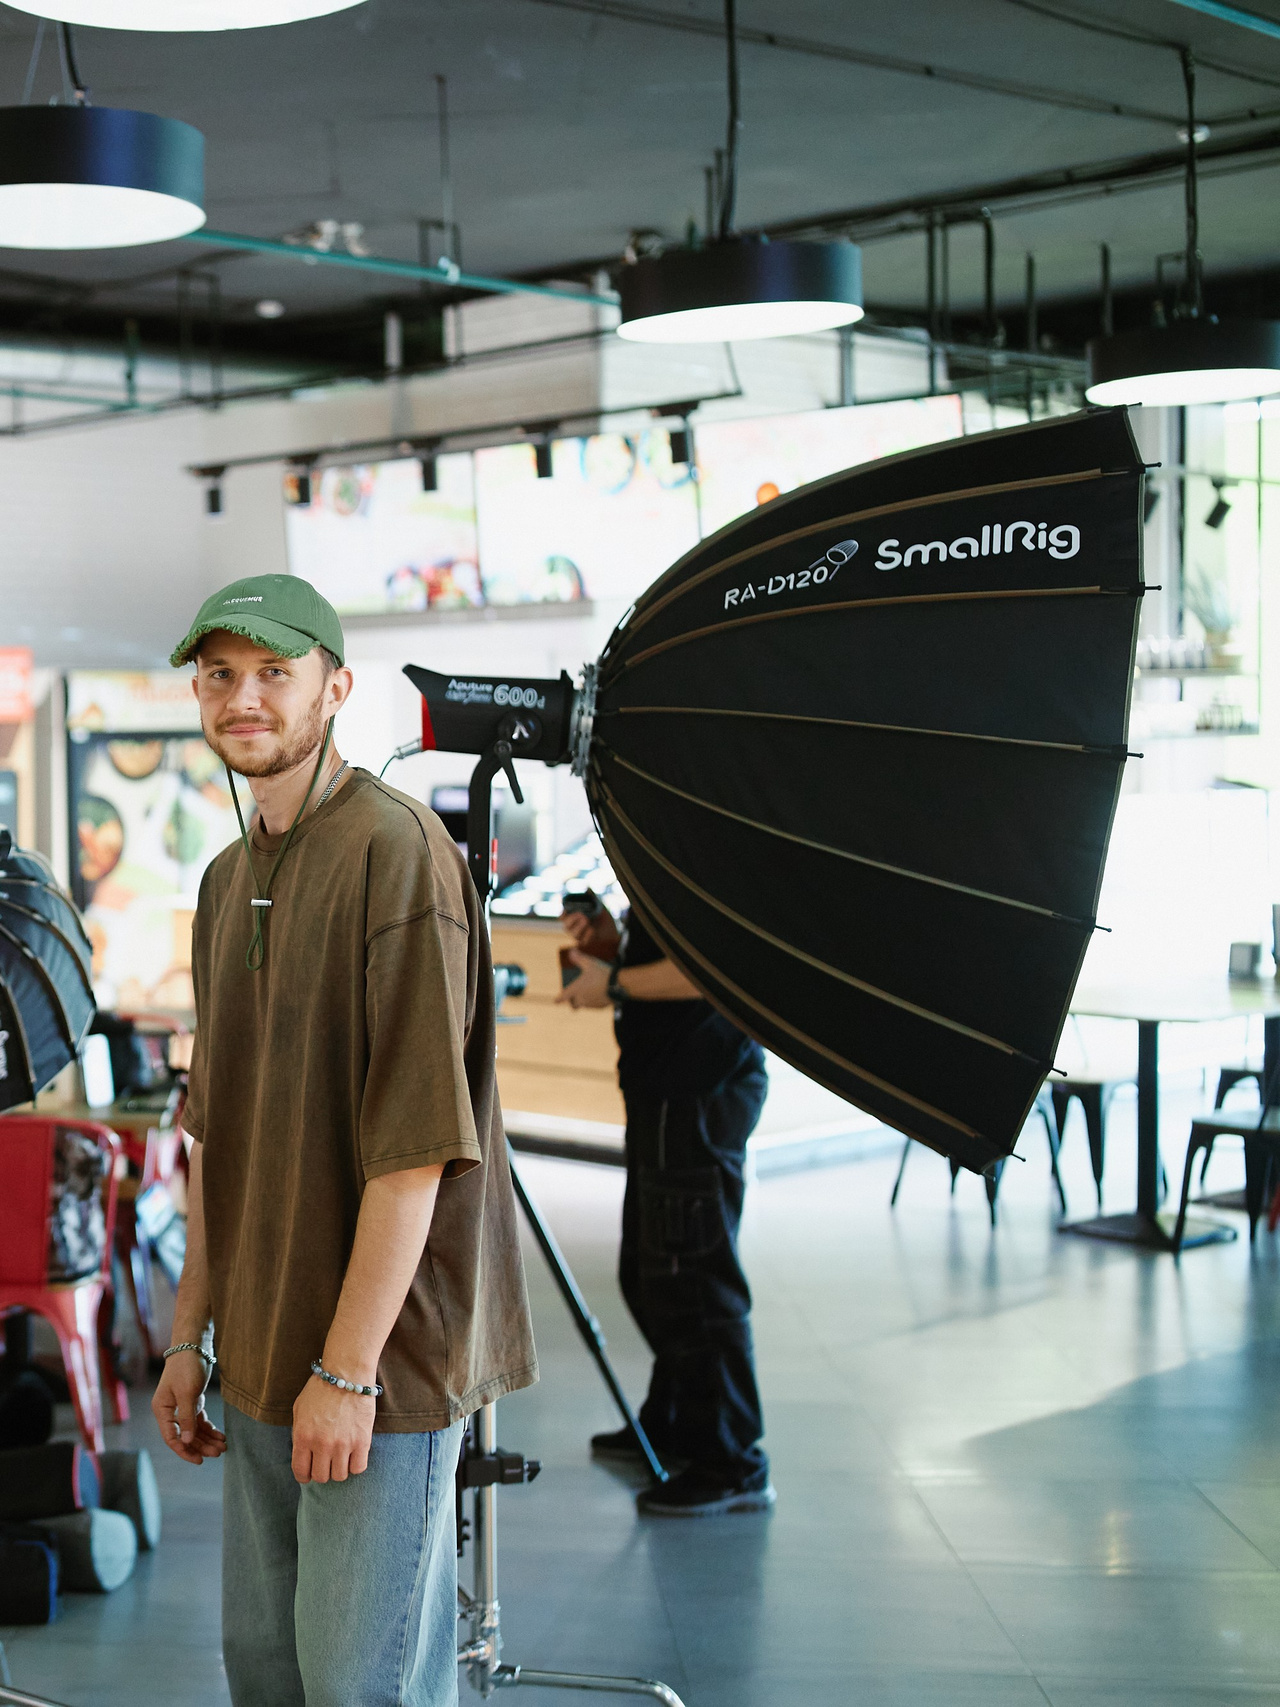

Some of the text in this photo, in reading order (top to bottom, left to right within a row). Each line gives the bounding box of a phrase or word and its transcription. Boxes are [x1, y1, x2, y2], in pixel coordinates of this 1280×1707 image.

[723, 520, 1082, 609] RA-D120 SmallRig
[447, 678, 493, 692] Aputure
